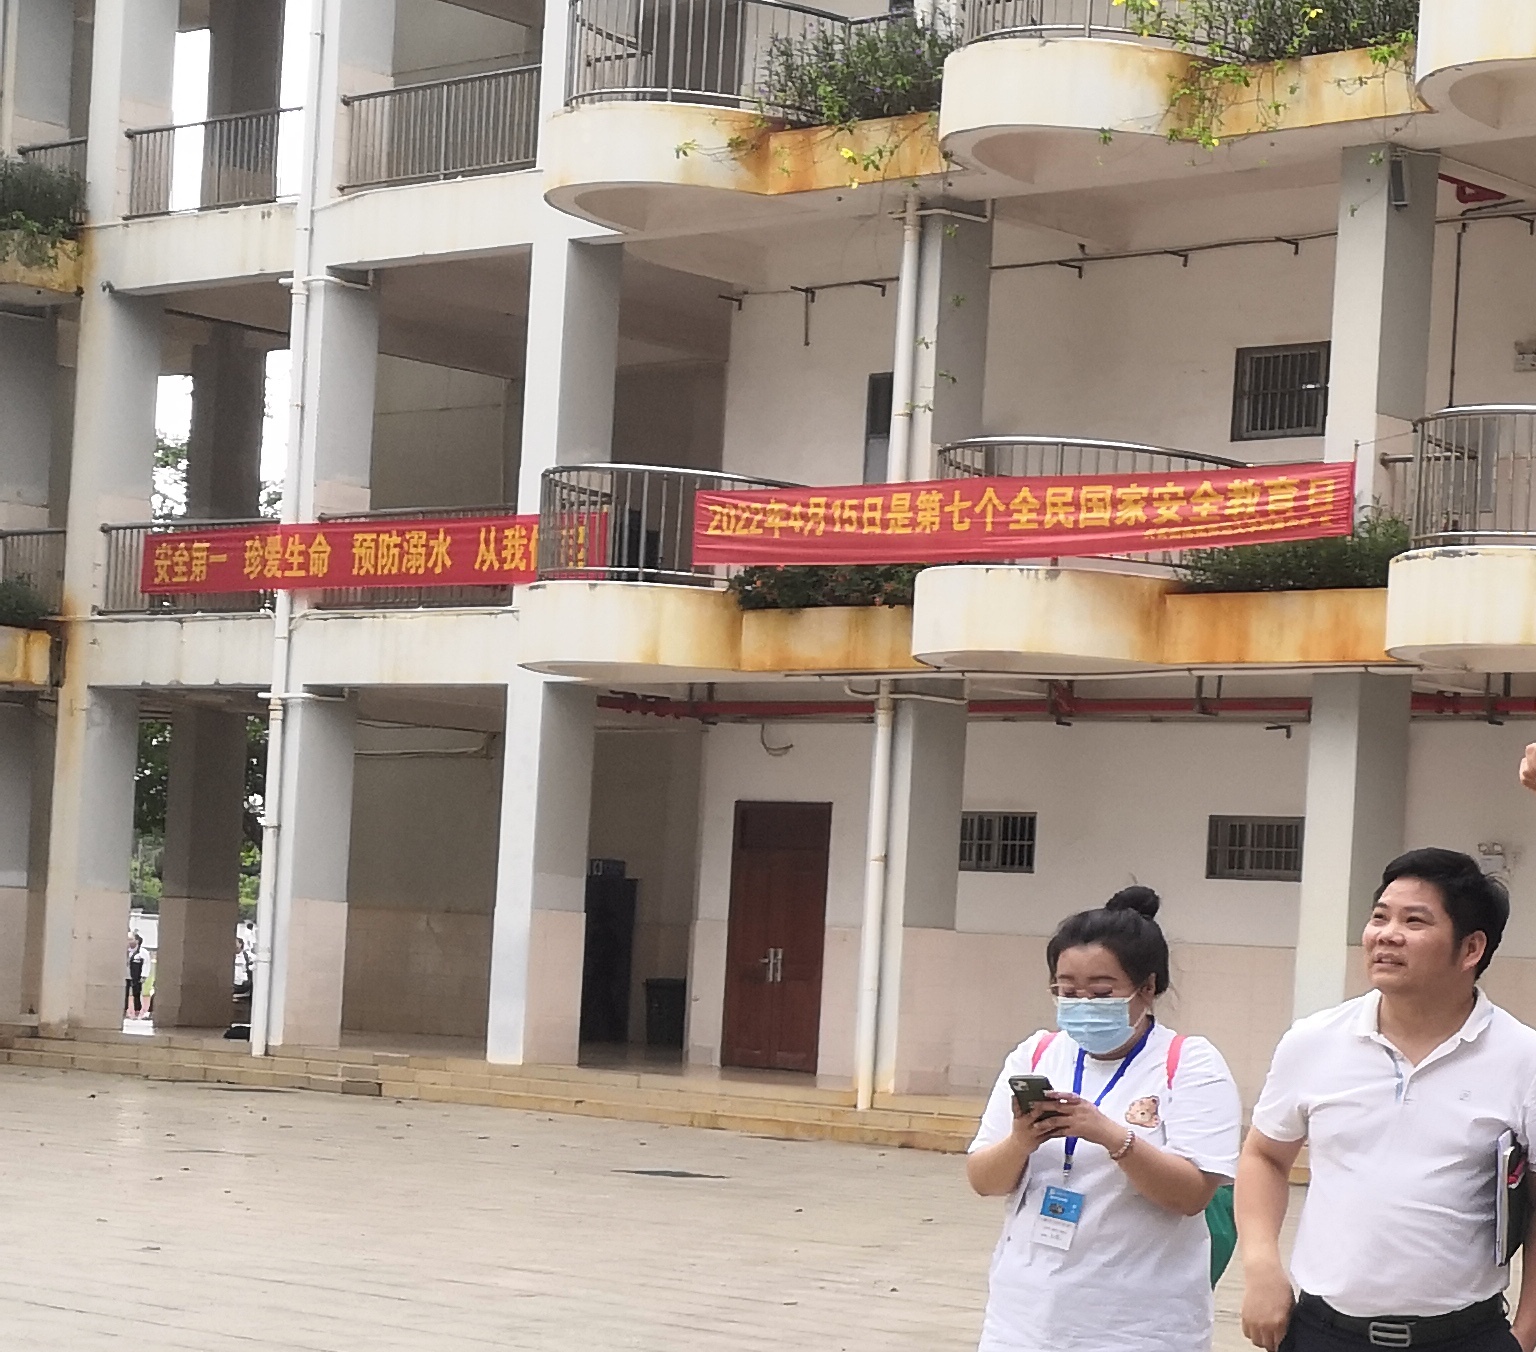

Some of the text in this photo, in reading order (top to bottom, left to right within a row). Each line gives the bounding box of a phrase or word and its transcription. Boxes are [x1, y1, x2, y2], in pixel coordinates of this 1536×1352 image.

[153, 540, 229, 585] 安全第一
[243, 532, 332, 580] 珍爱生命
[351, 527, 453, 577] 预防溺水
